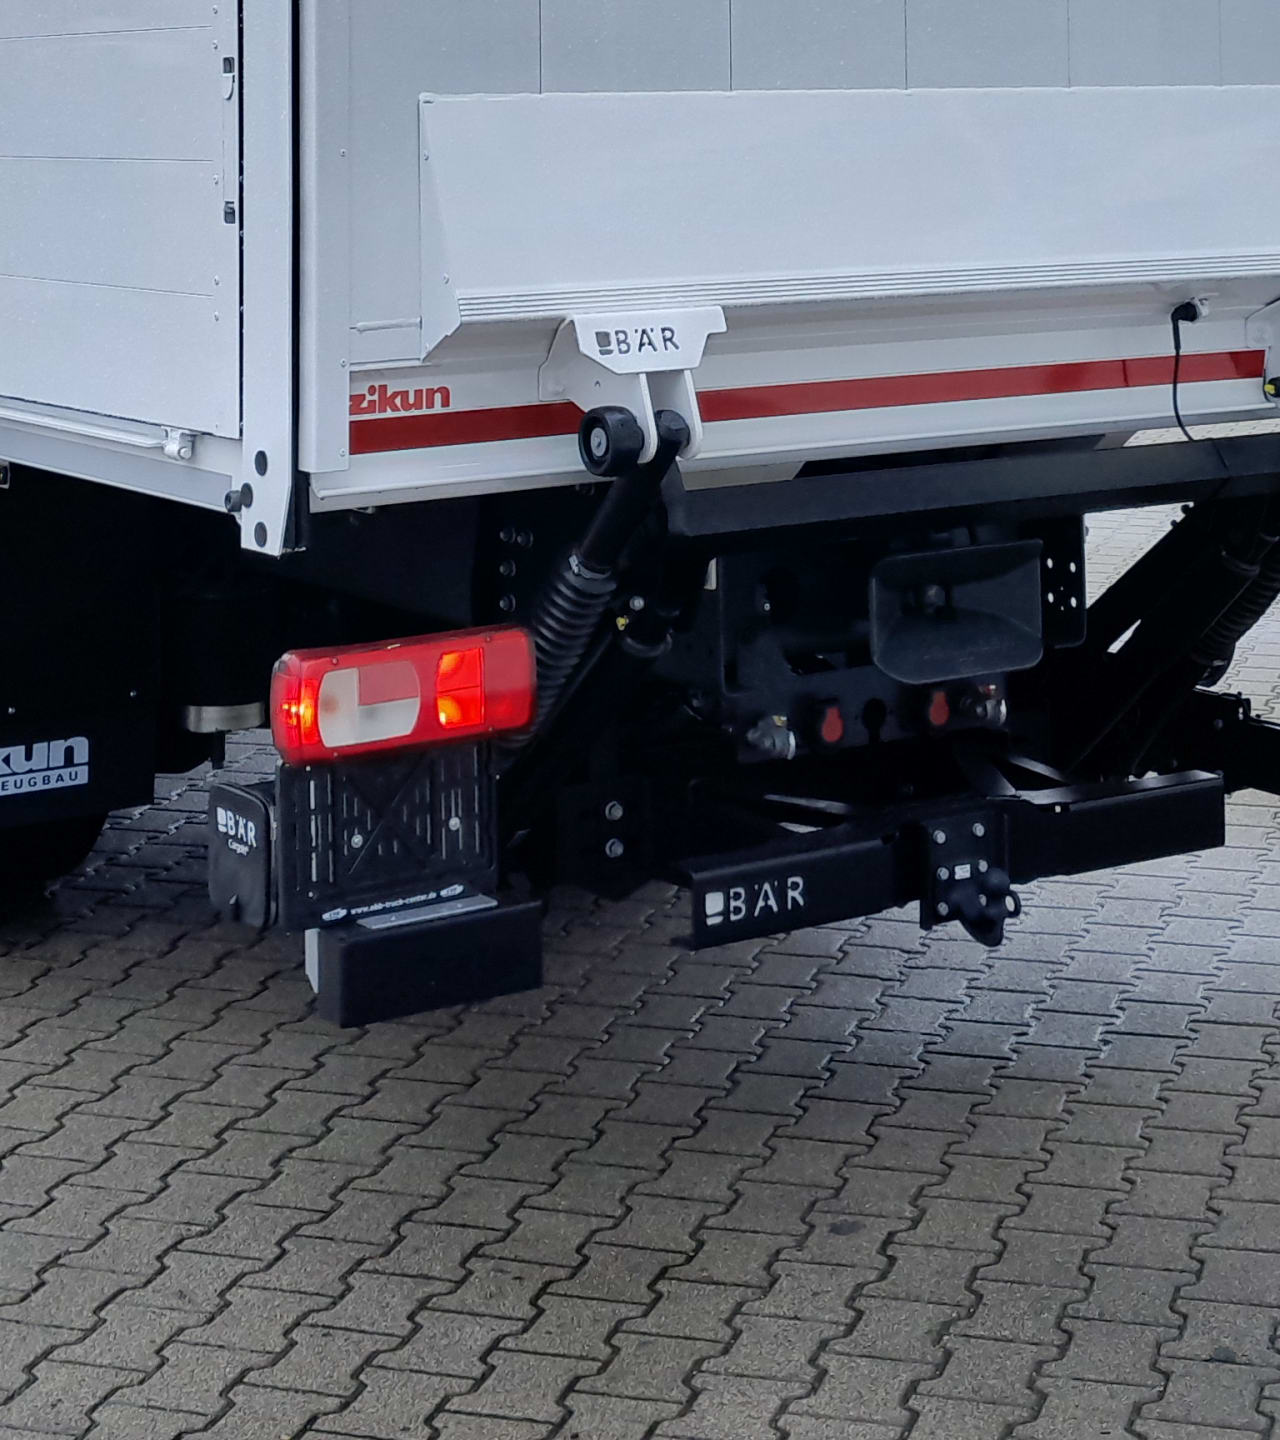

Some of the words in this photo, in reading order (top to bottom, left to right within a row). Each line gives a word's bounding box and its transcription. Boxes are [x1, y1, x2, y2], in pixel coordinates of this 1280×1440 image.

[614, 327, 680, 355] BÄR
[349, 384, 450, 415] zikun
[226, 810, 257, 848] BÄR
[729, 876, 804, 922] BÄR
